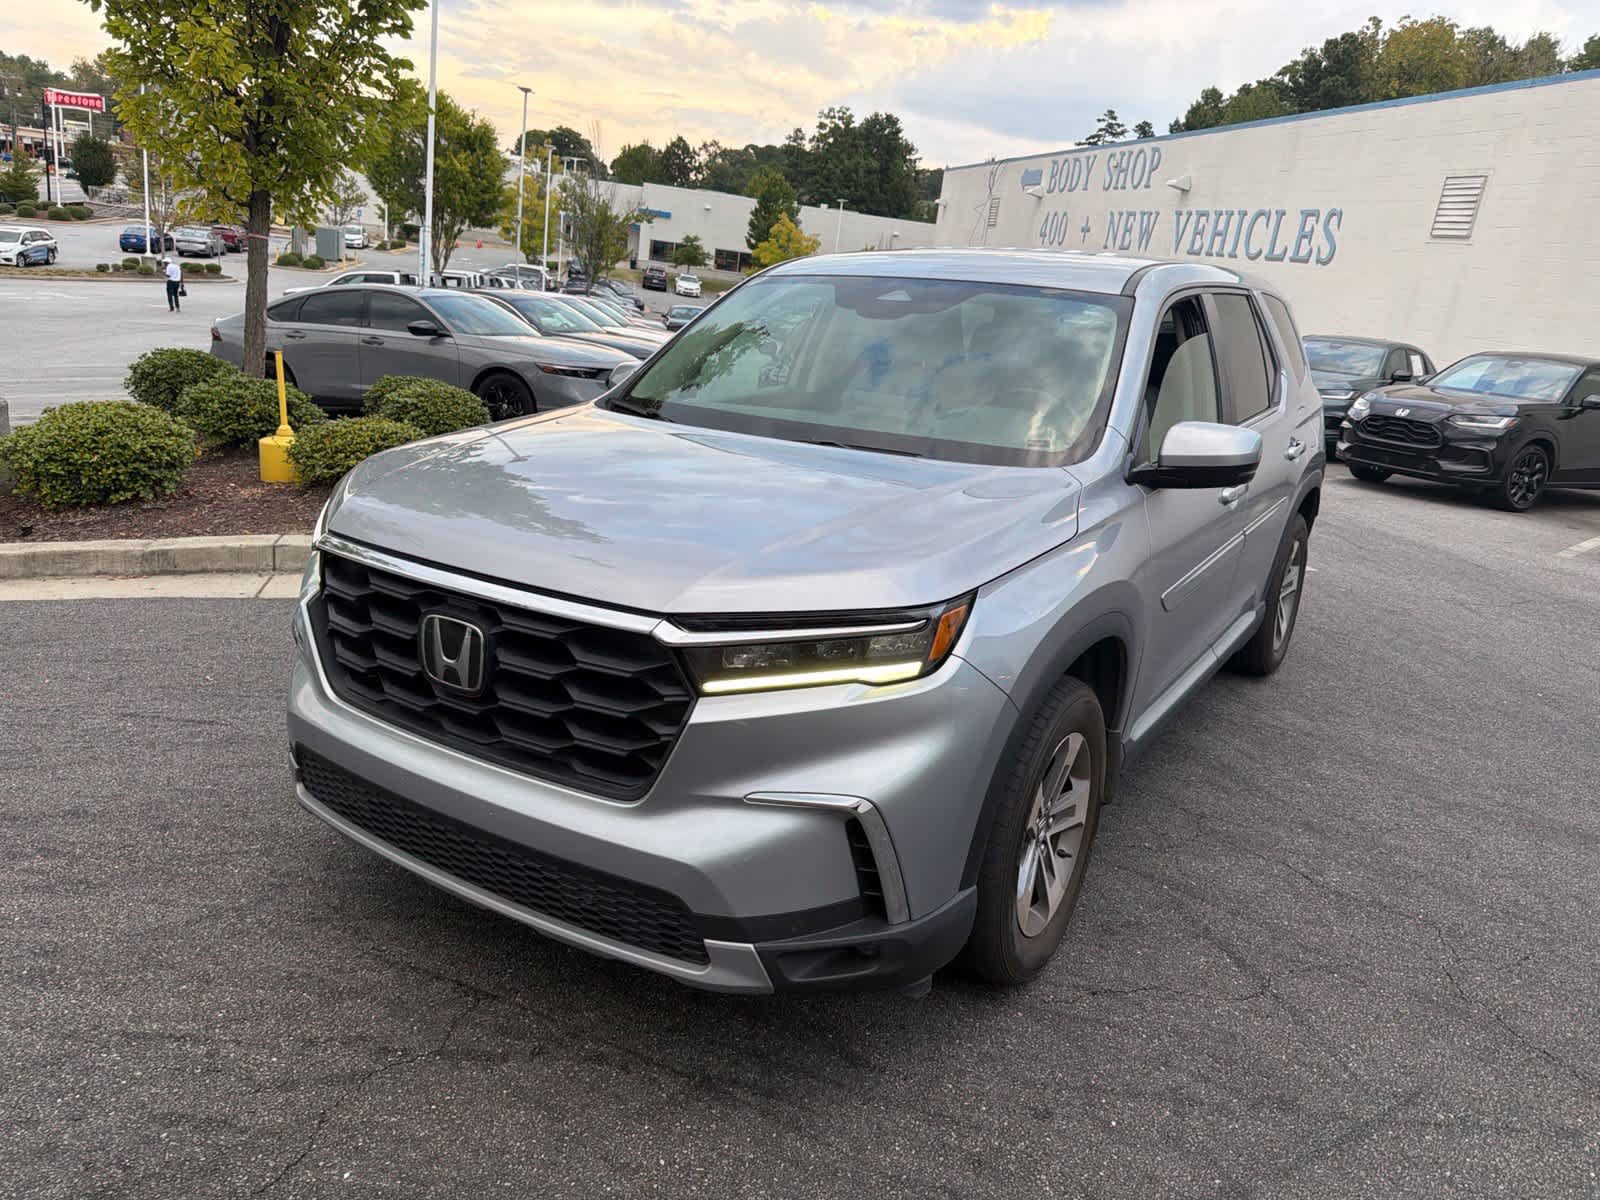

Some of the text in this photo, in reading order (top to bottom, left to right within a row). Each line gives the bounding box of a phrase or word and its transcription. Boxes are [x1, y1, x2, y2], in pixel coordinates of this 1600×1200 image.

[1046, 147, 1161, 194] BODY SHOP
[1039, 211, 1069, 247] 400
[1103, 211, 1160, 251] NEW
[1172, 208, 1343, 266] VEHICLES
